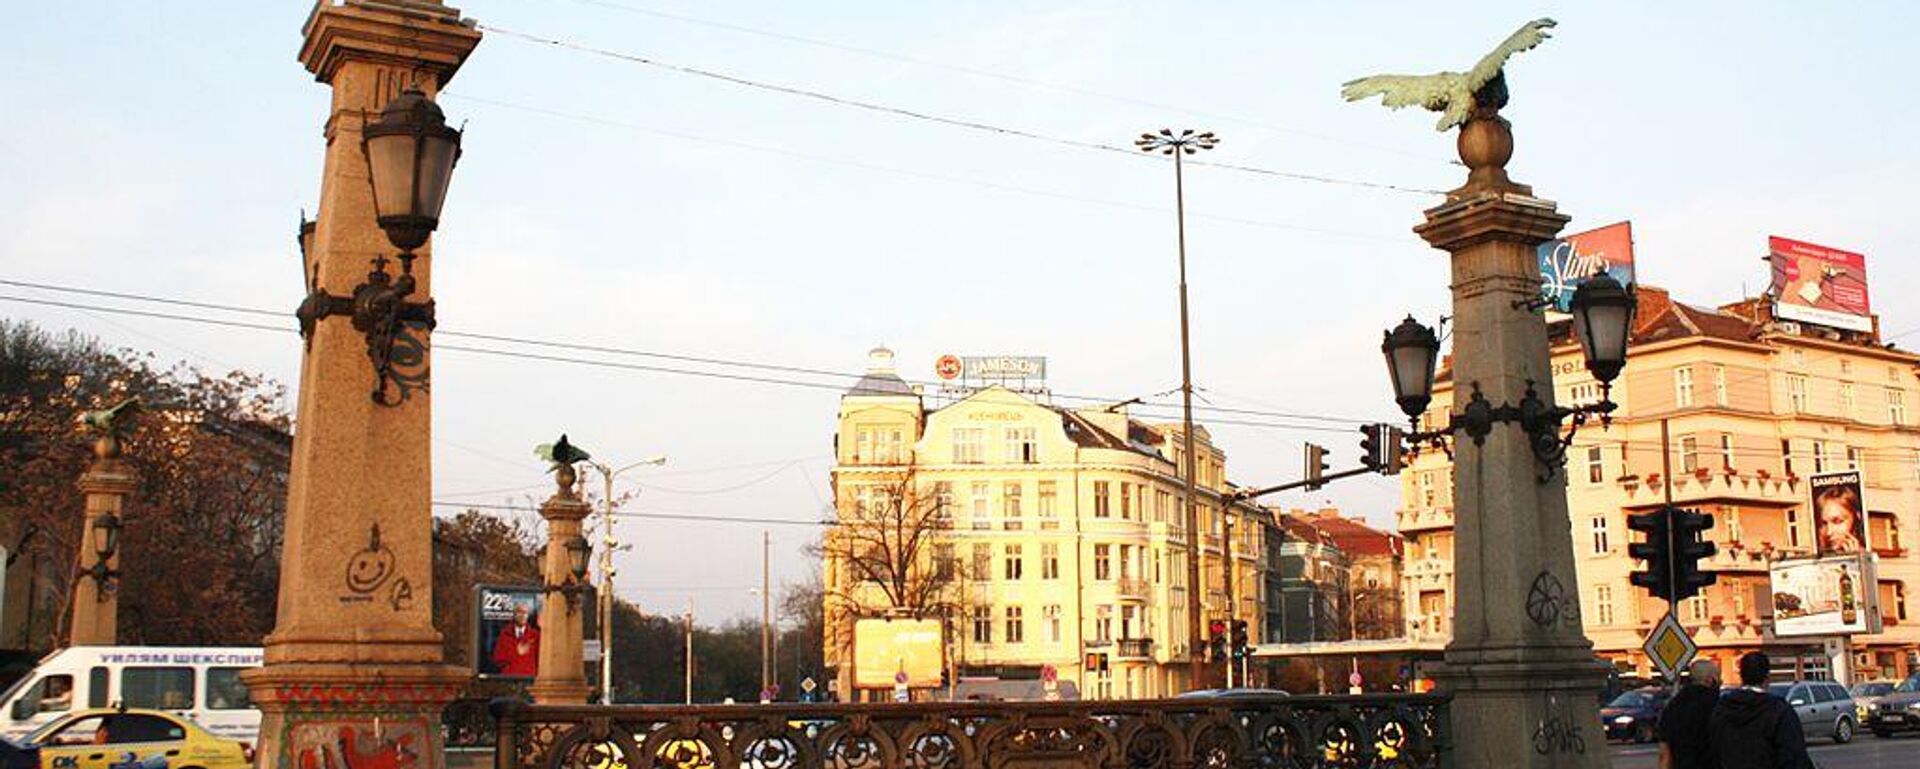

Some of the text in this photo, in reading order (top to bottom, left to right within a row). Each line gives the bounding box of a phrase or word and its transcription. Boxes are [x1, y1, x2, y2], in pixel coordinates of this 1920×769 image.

[970, 357, 1040, 375] JAMESON
[1813, 475, 1857, 487] SAMSUNG
[100, 653, 168, 664] УИЛЯМ
